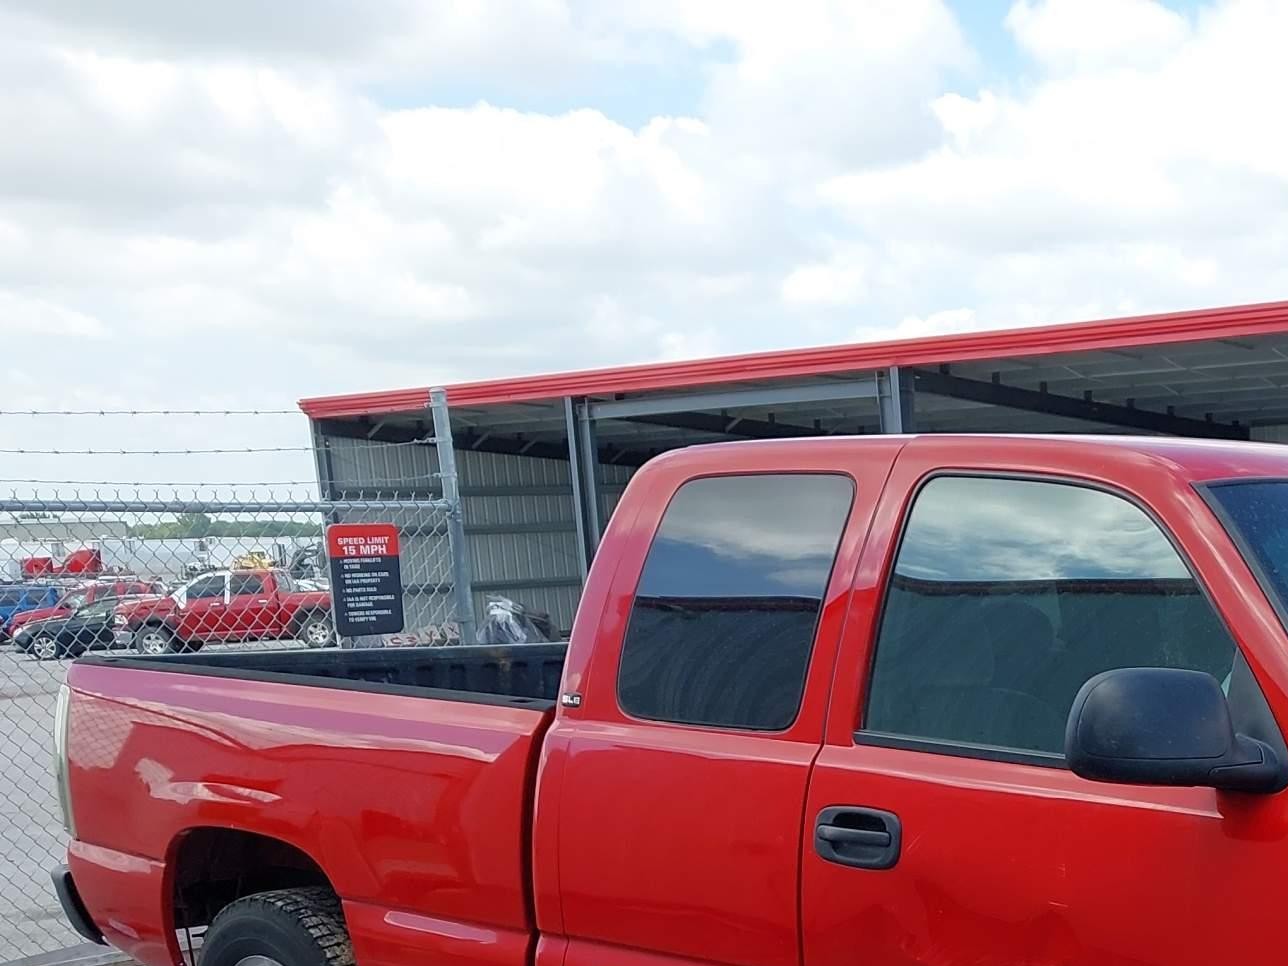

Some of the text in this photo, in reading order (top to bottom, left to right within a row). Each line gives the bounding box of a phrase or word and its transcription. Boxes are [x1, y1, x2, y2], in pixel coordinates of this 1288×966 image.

[337, 536, 390, 545] SPEED LIMIT
[342, 544, 387, 555] 15 MPH
